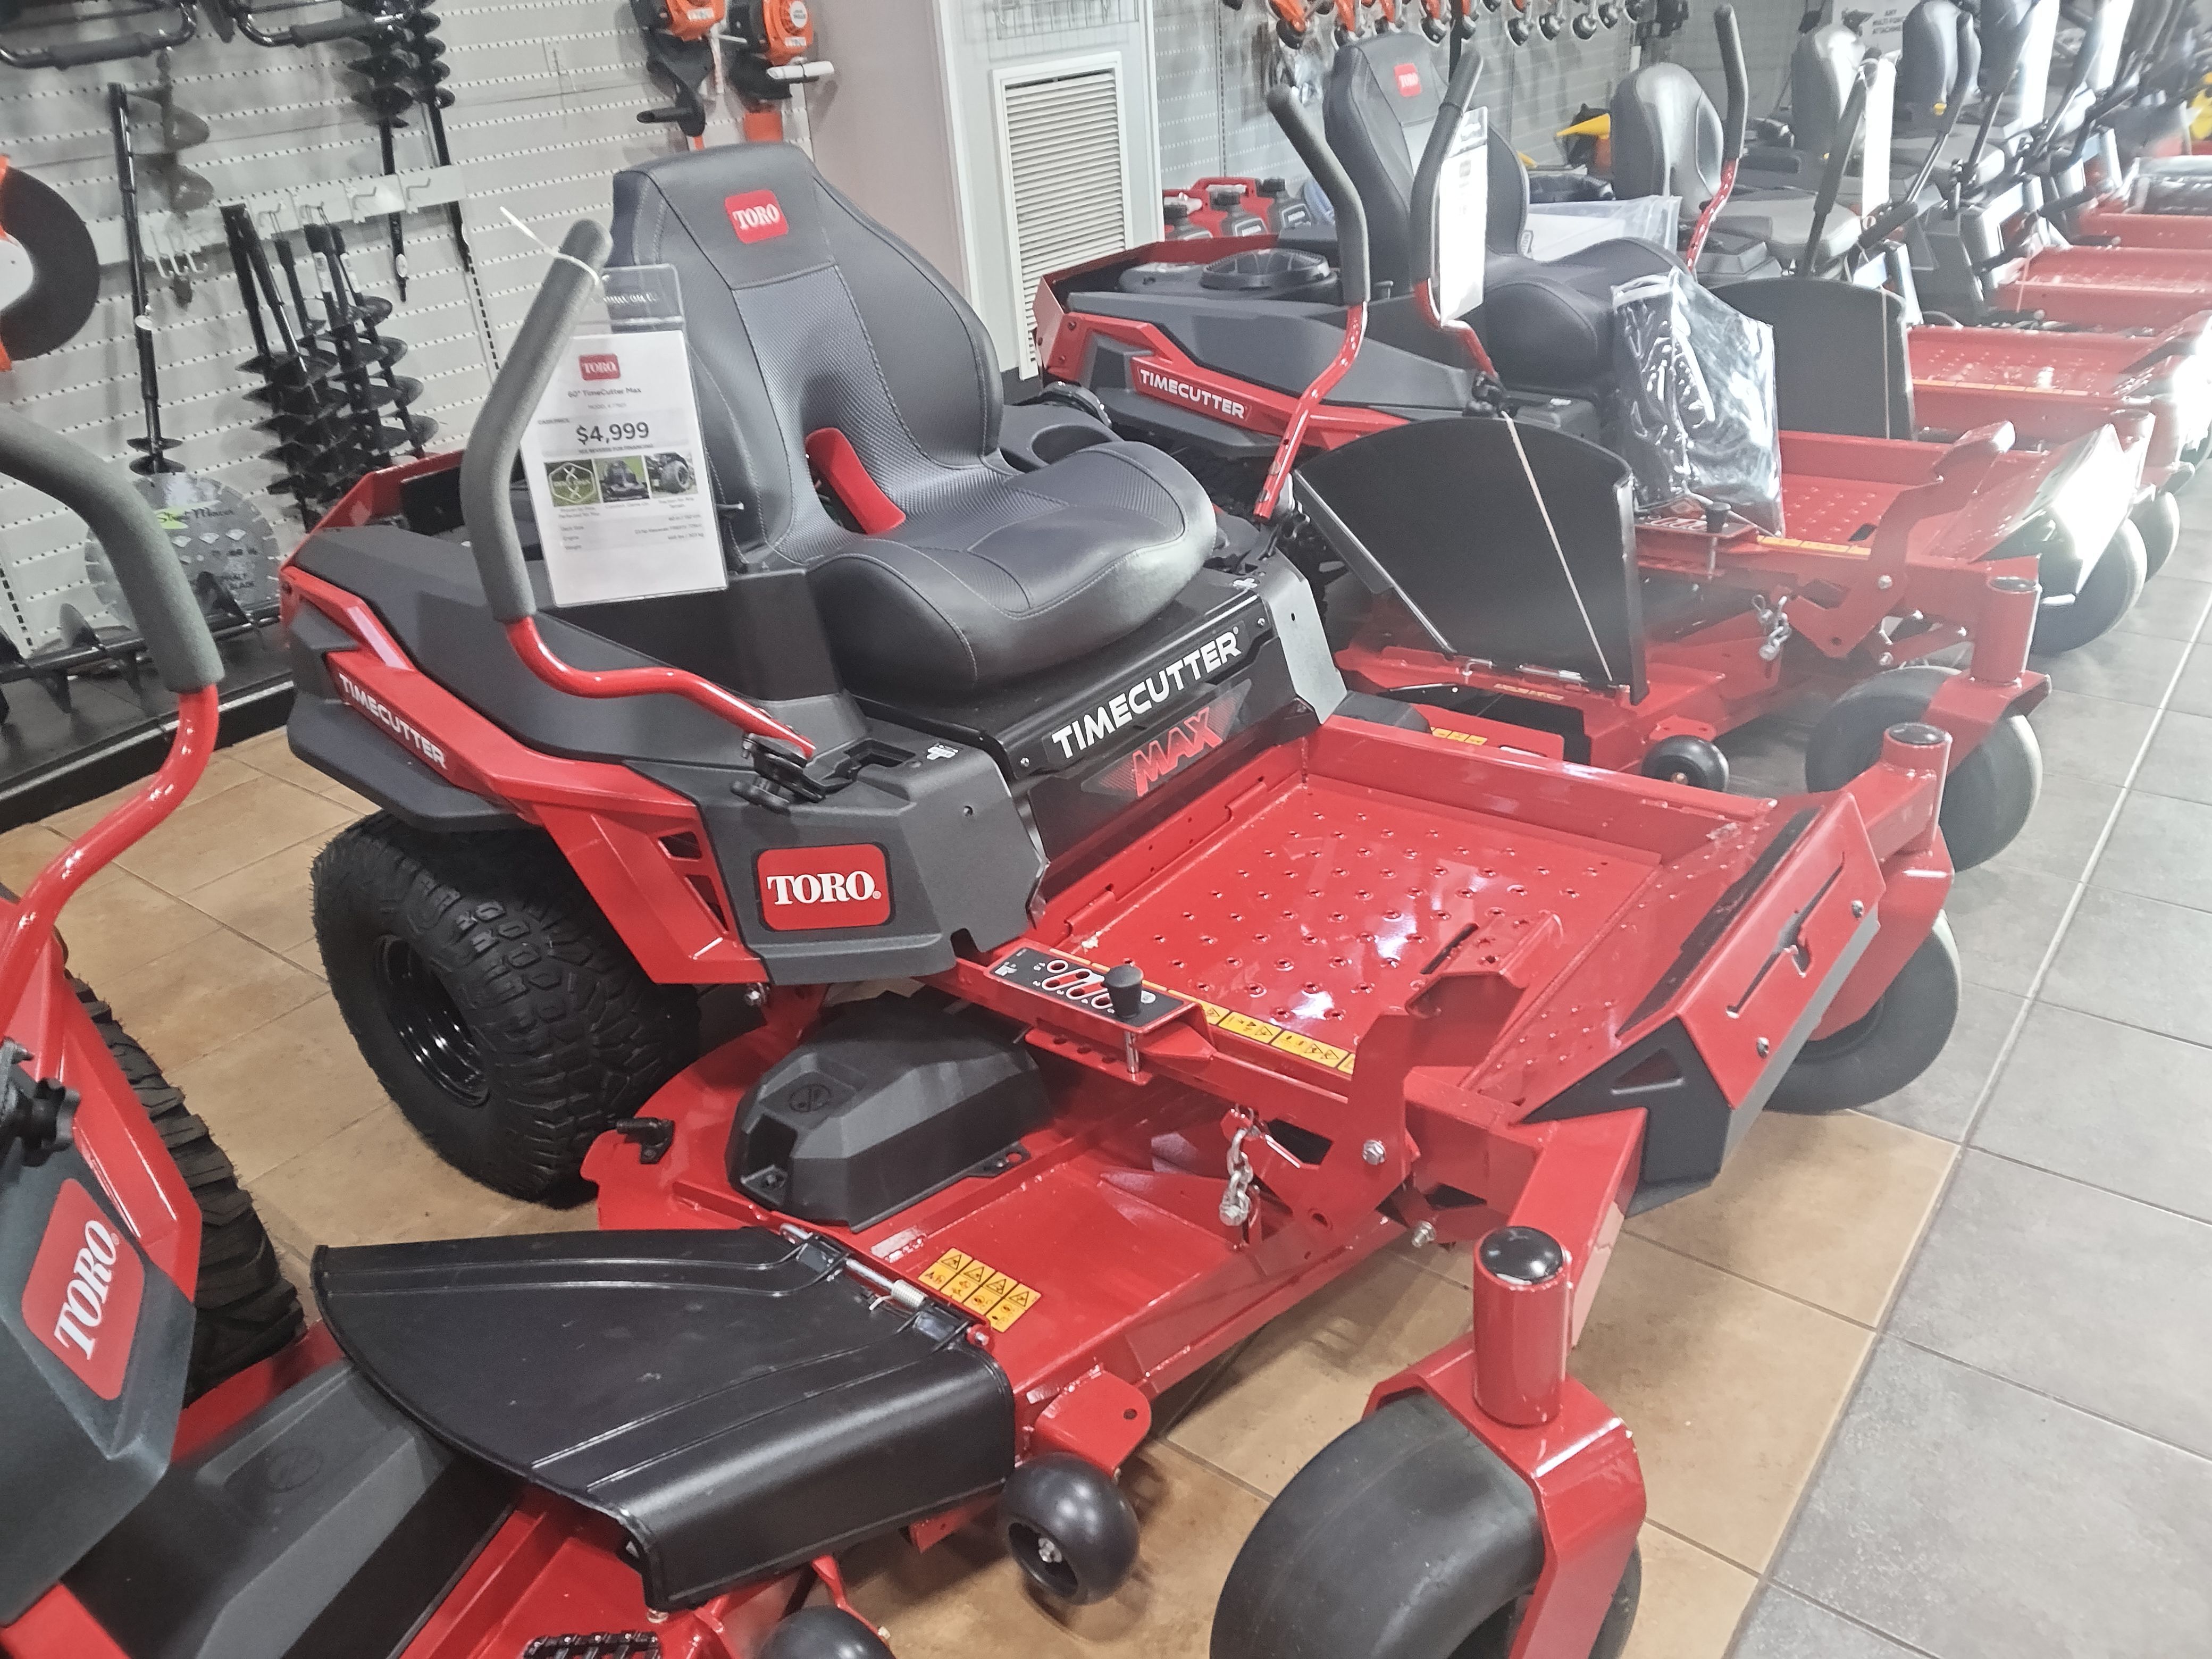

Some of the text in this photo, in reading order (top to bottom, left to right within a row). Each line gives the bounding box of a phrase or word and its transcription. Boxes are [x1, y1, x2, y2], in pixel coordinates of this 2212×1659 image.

[1398, 72, 1419, 88] TORO
[733, 204, 781, 230] TORO
[583, 361, 617, 374] TORO
[1139, 369, 1246, 419] TIMECUTTER
[576, 422, 649, 445] $4,999
[1052, 631, 1243, 759] TIMECUTTER
[338, 673, 447, 769] TIMECUTTER
[1132, 707, 1223, 797] MAX
[767, 870, 876, 905] TORO
[54, 1220, 118, 1361] TORO
